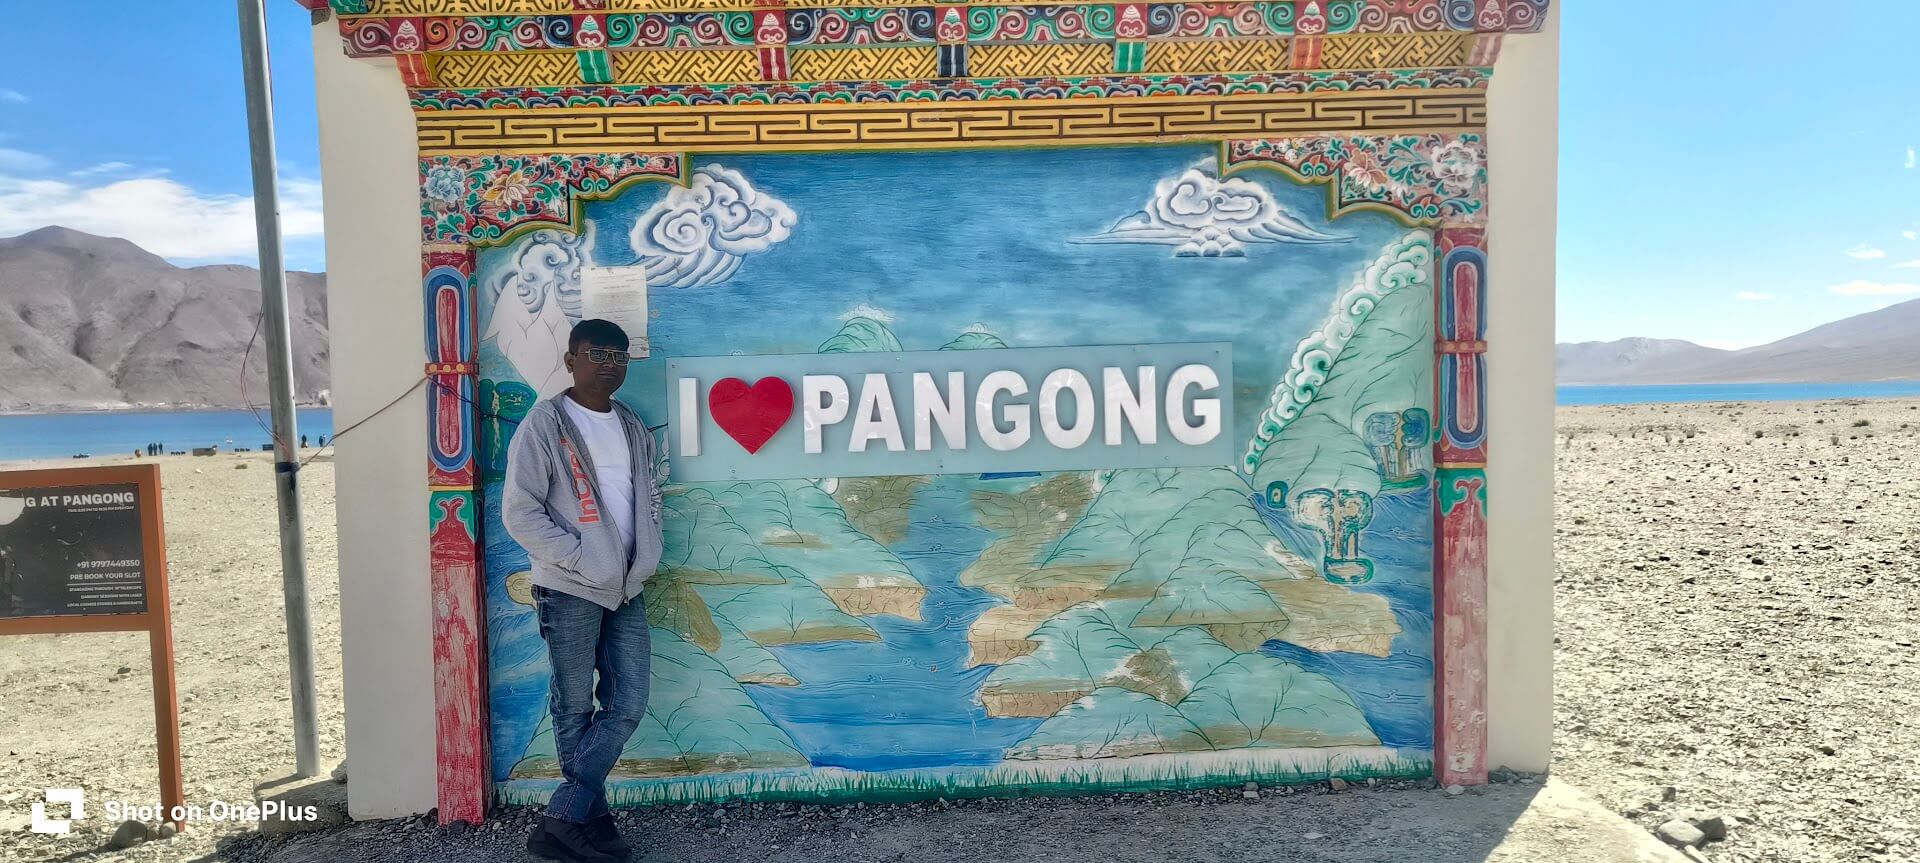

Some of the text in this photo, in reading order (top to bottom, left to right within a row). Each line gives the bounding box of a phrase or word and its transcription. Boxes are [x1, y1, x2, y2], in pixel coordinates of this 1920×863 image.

[678, 364, 1222, 457] I PANGONG
[41, 496, 60, 507] AT
[63, 492, 135, 506] PANGONG
[77, 559, 140, 569] +91 9797449350
